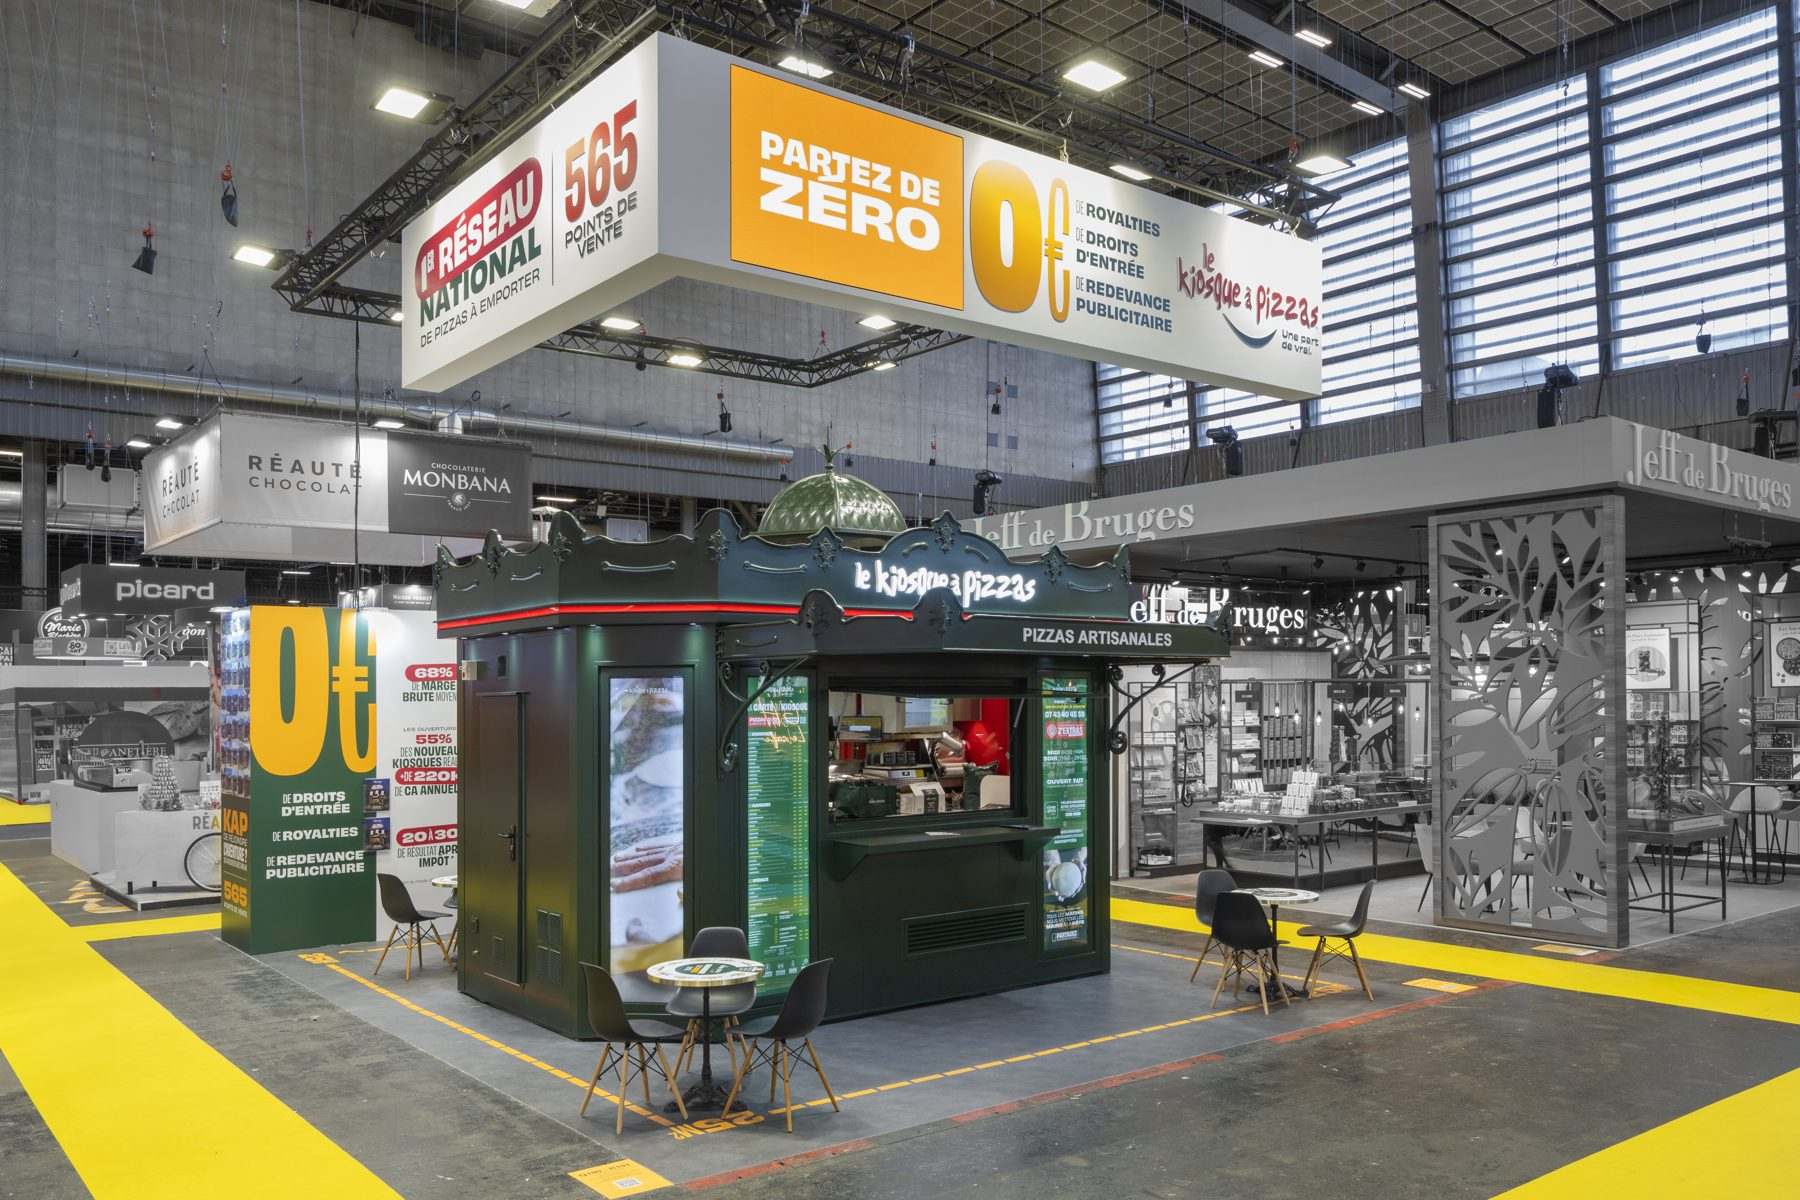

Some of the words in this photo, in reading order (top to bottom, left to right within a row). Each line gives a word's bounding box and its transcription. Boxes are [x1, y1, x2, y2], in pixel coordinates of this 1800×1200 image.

[565, 100, 638, 223] 565
[761, 131, 891, 193] PARTEZ
[900, 171, 940, 207] DE
[565, 206, 613, 249] POINTS
[617, 192, 637, 216] DE
[760, 167, 940, 251] ZERO
[1075, 200, 1084, 215] DE
[1086, 203, 1160, 237] ROYALTIES
[438, 171, 534, 280] RÉSEAU
[577, 220, 623, 259] VENTE
[970, 160, 1070, 323] 0€
[1075, 227, 1084, 243] DE
[1086, 231, 1138, 257] DROITS
[1076, 248, 1144, 279] D'ENTRÉE
[1203, 243, 1214, 272] le
[420, 227, 541, 327] NATIONAL
[420, 332, 432, 347] DE
[434, 311, 468, 341] PIZZAS
[470, 301, 478, 319] À
[480, 268, 541, 312] EMPORTER
[1075, 276, 1084, 291] DE
[1086, 279, 1171, 312] REDEVANCE
[1177, 256, 1241, 310] kiosque
[1256, 285, 1319, 329] pizzas
[1076, 298, 1172, 333] PUBLICITAIRE
[1281, 341, 1292, 352] de
[1282, 329, 1298, 342] Une
[162, 456, 200, 497] RÉAUTÉ
[248, 453, 363, 479] RÉAUTÉ
[431, 462, 487, 474] CHOCOLATERIE
[1626, 422, 1681, 486] Jeff
[1684, 453, 1704, 489] de
[1708, 443, 1792, 512] Bruges
[403, 468, 512, 495] MONBANA
[162, 489, 200, 519] CHOCOLAT
[1029, 520, 1056, 547] de
[1060, 500, 1195, 544] Bruges
[116, 579, 214, 601] picard
[854, 562, 871, 590] le
[963, 570, 1036, 608] pizzas
[1023, 627, 1074, 645] PIZZAS
[1078, 629, 1172, 648] ARTISANALES
[414, 667, 453, 679] 68%
[421, 681, 456, 691] MARGE
[250, 606, 377, 776] 0€
[402, 692, 434, 702] BRUTE
[400, 748, 412, 758] DES
[415, 734, 453, 745] 55%
[392, 757, 442, 769] KIOSQUES
[282, 793, 292, 804] DE
[293, 791, 346, 804] DROITS
[394, 787, 404, 797] DE
[404, 786, 418, 796] CA
[223, 807, 248, 838] KAP
[281, 800, 350, 816] D'ENTRÉE
[272, 831, 282, 841] DE
[282, 827, 359, 842] ROYALTIES
[402, 832, 427, 844] 20
[266, 856, 276, 867] DE
[276, 851, 365, 867] REDEVANCE
[266, 863, 365, 880] PUBLICITAIRE
